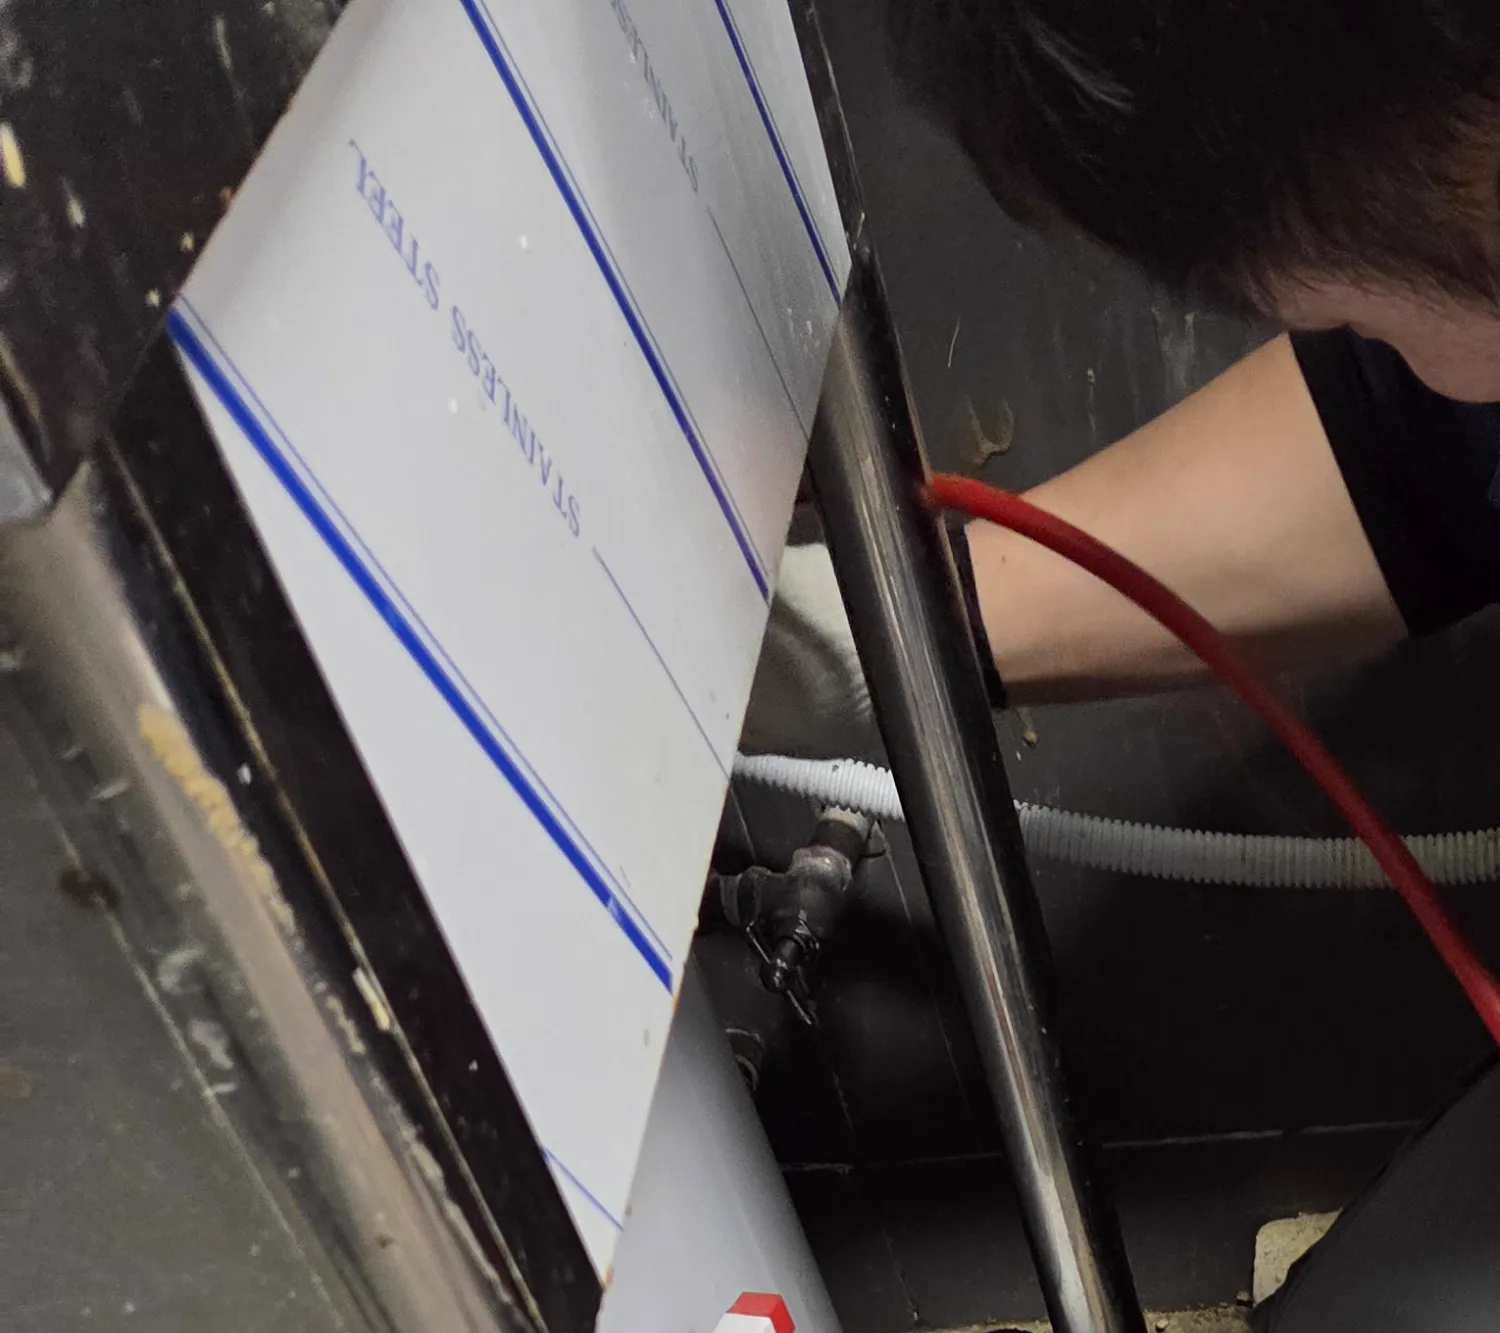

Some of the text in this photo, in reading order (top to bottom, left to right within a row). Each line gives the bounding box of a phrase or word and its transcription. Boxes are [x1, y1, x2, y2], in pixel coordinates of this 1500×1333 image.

[610, 0, 699, 193] STAINLES
[347, 138, 581, 539] STAINLESS STEEL
